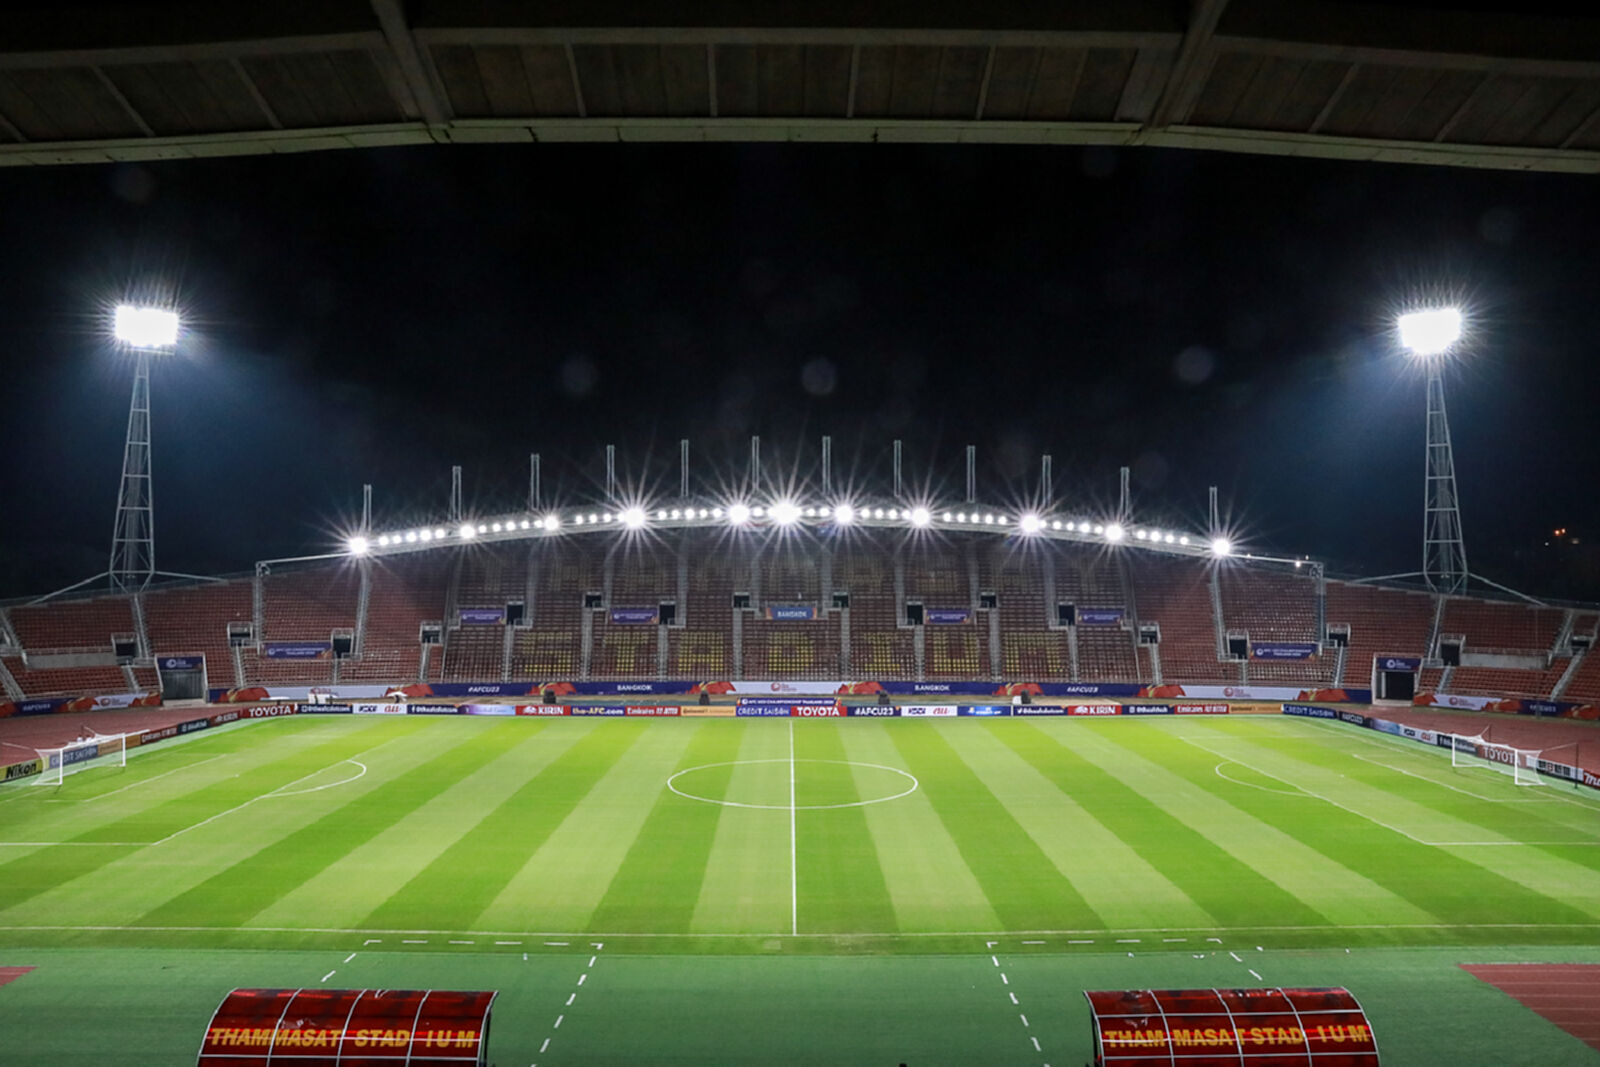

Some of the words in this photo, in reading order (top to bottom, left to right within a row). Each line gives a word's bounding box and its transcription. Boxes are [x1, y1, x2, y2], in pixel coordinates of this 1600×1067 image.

[248, 705, 291, 717] TOYOTA
[538, 706, 564, 714] KIRIN
[572, 707, 624, 715] the-AFC.com
[738, 707, 762, 715] CREDIT
[797, 706, 839, 716] TOYOTA
[854, 707, 894, 715] #AFCU23
[1089, 706, 1116, 714] KIRIN
[6, 762, 37, 779] Nikon
